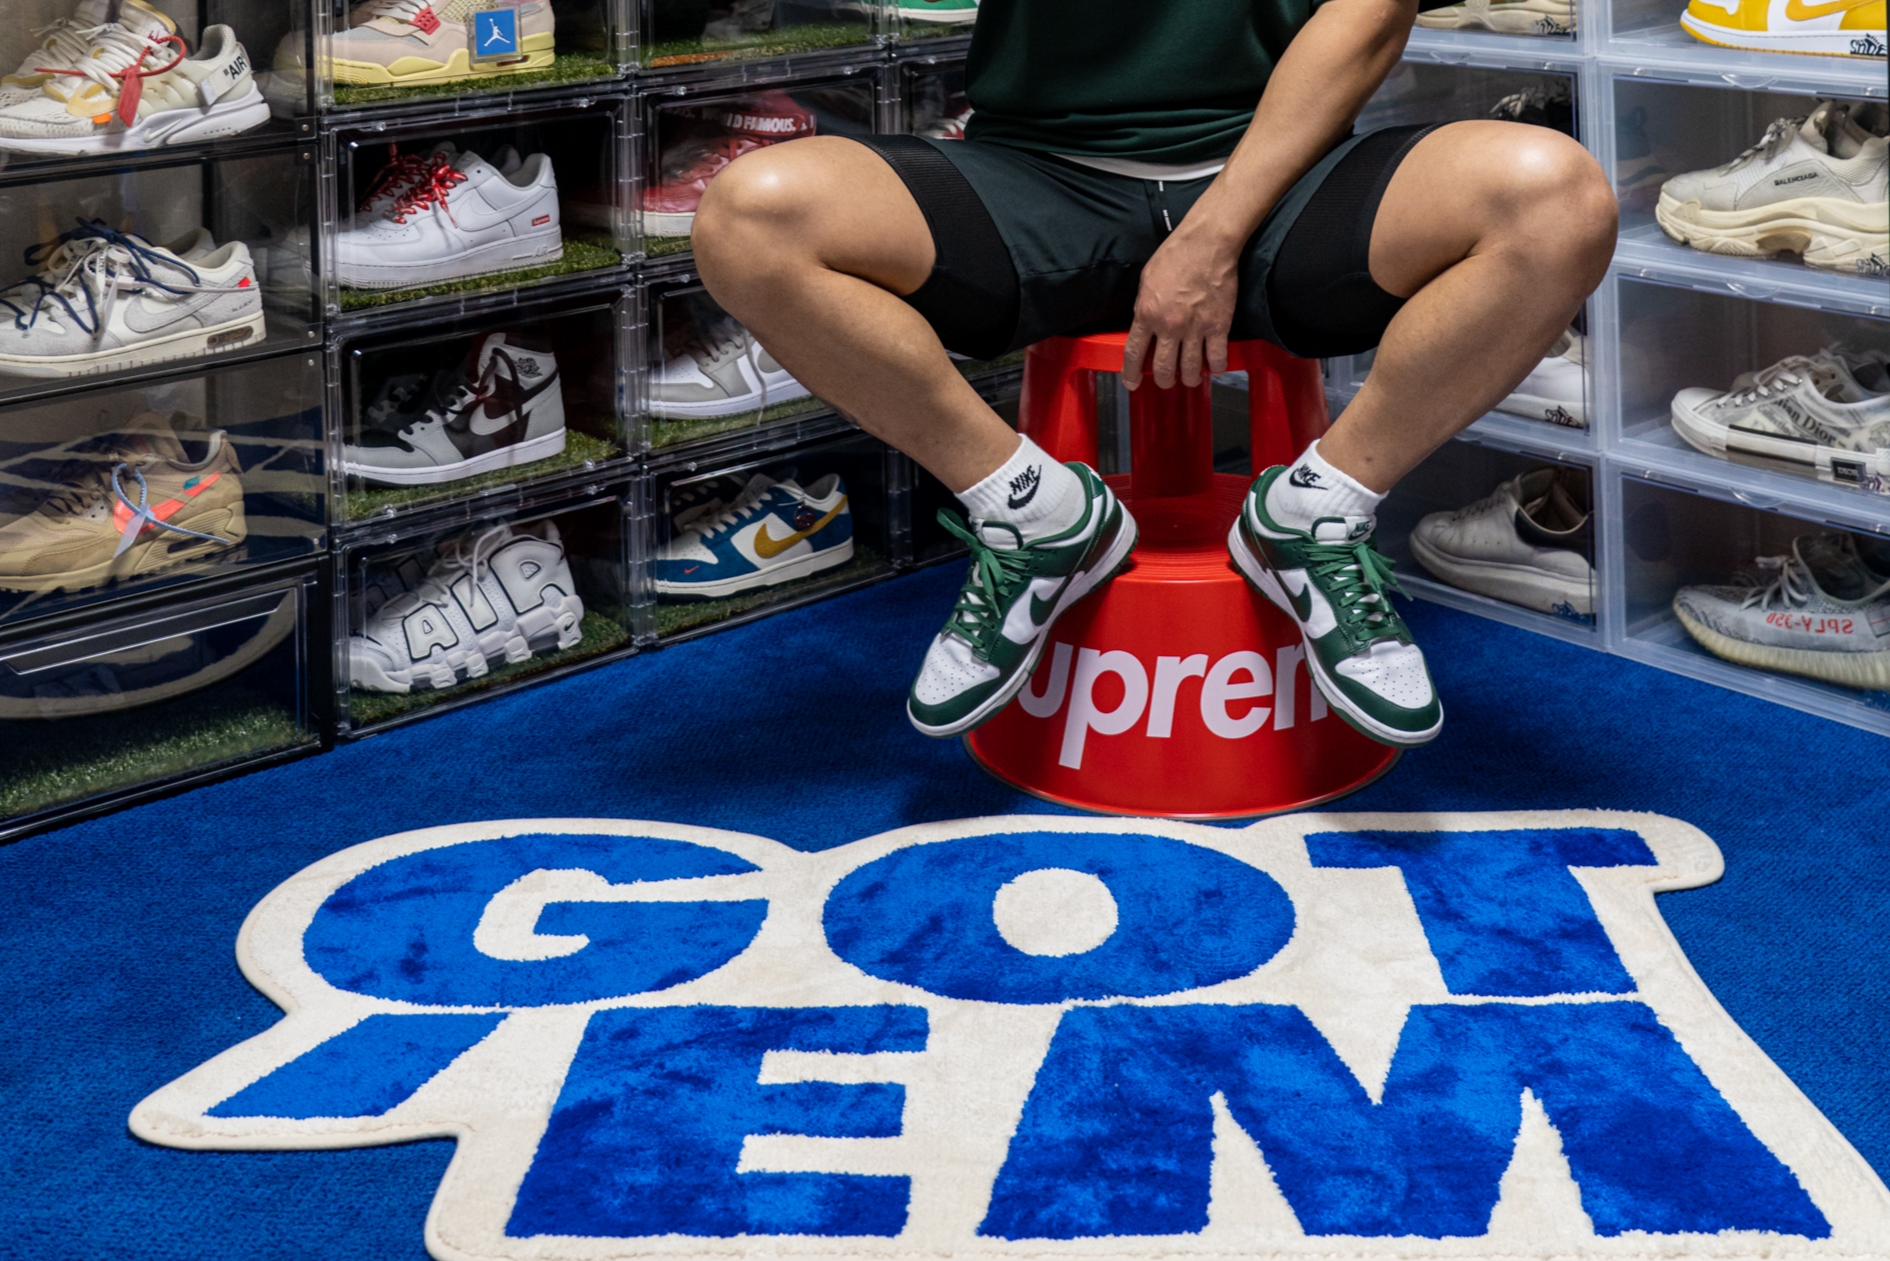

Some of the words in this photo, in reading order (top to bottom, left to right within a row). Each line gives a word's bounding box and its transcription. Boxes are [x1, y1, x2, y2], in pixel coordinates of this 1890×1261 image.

[1802, 416, 1837, 446] Dior
[1009, 465, 1035, 495] NIKE
[403, 541, 568, 660] AIR
[303, 829, 1655, 1007] GOT
